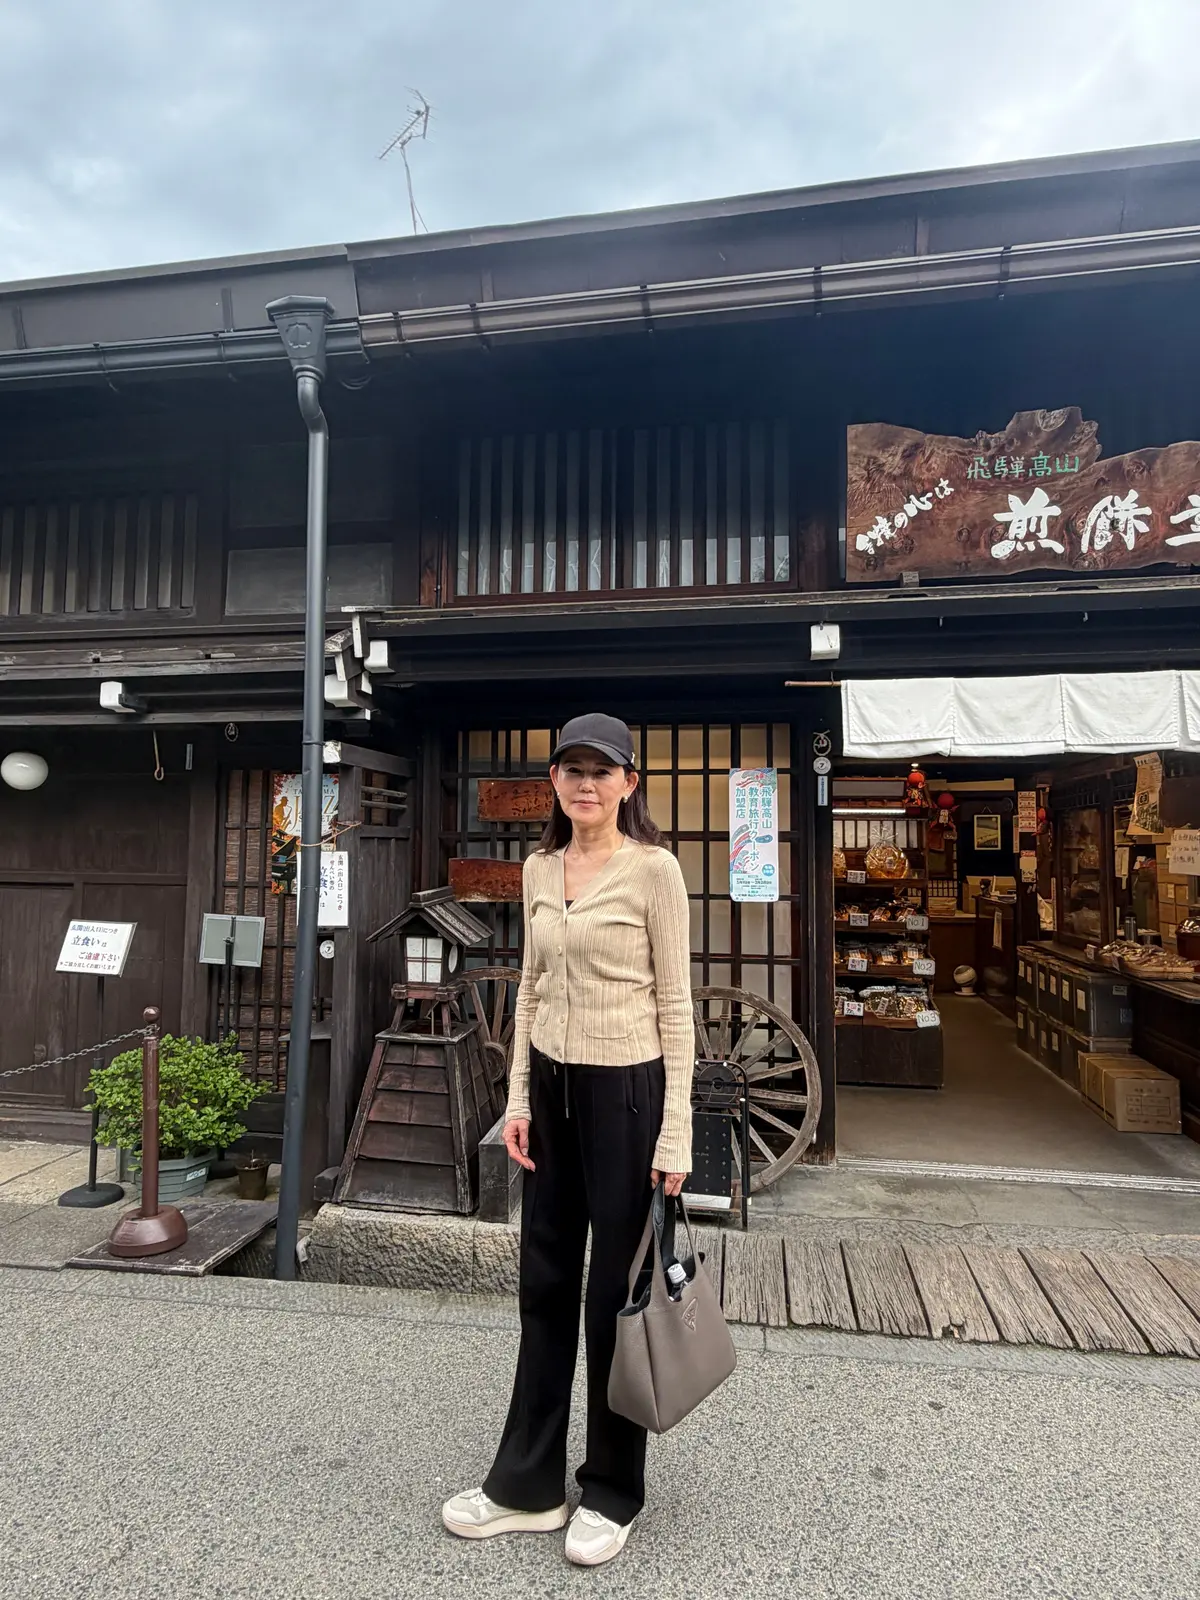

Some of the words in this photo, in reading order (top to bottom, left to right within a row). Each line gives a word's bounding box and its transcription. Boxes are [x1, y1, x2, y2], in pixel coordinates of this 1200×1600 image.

[290, 795, 336, 831] JZ
[735, 788, 746, 818] 加盟店
[749, 787, 759, 871] 教育旅行クーポン
